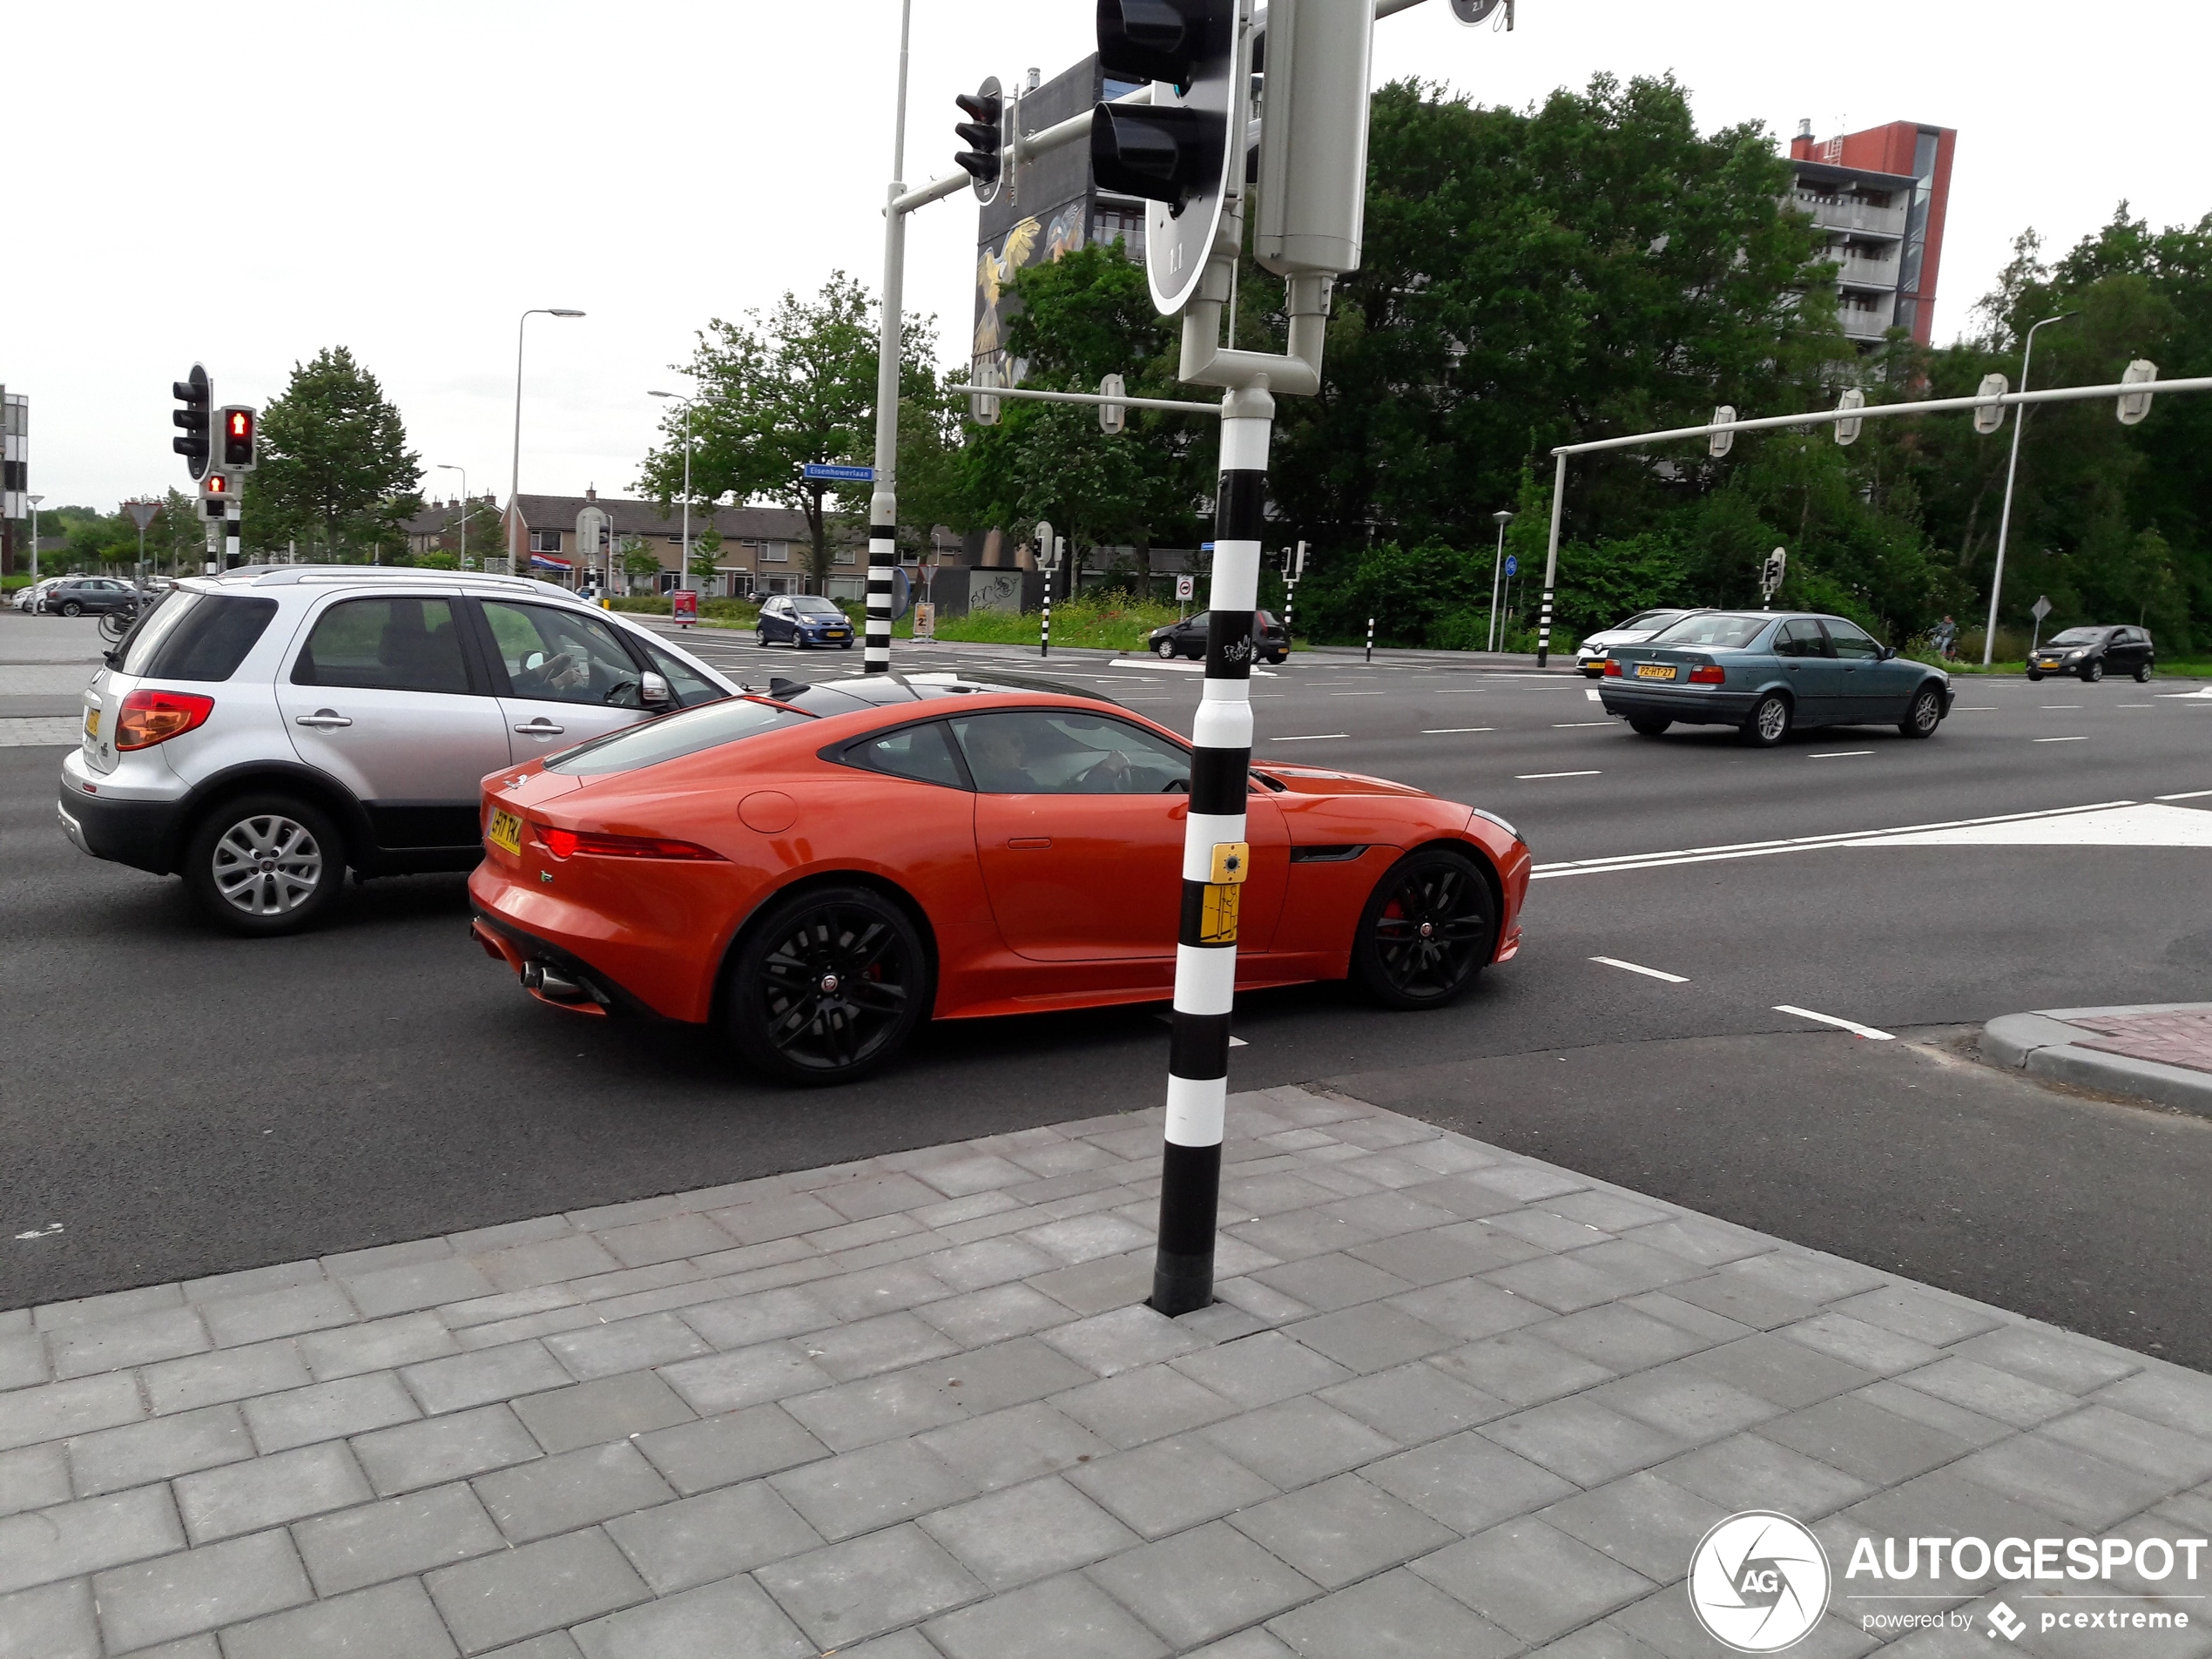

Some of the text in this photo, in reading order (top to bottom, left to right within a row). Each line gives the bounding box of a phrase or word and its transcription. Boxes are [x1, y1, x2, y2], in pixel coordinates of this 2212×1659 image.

[1170, 242, 1183, 275] 1.1
[810, 467, 869, 478] Eisenhowerlaan
[1641, 667, 1673, 677] PZ-HT-27
